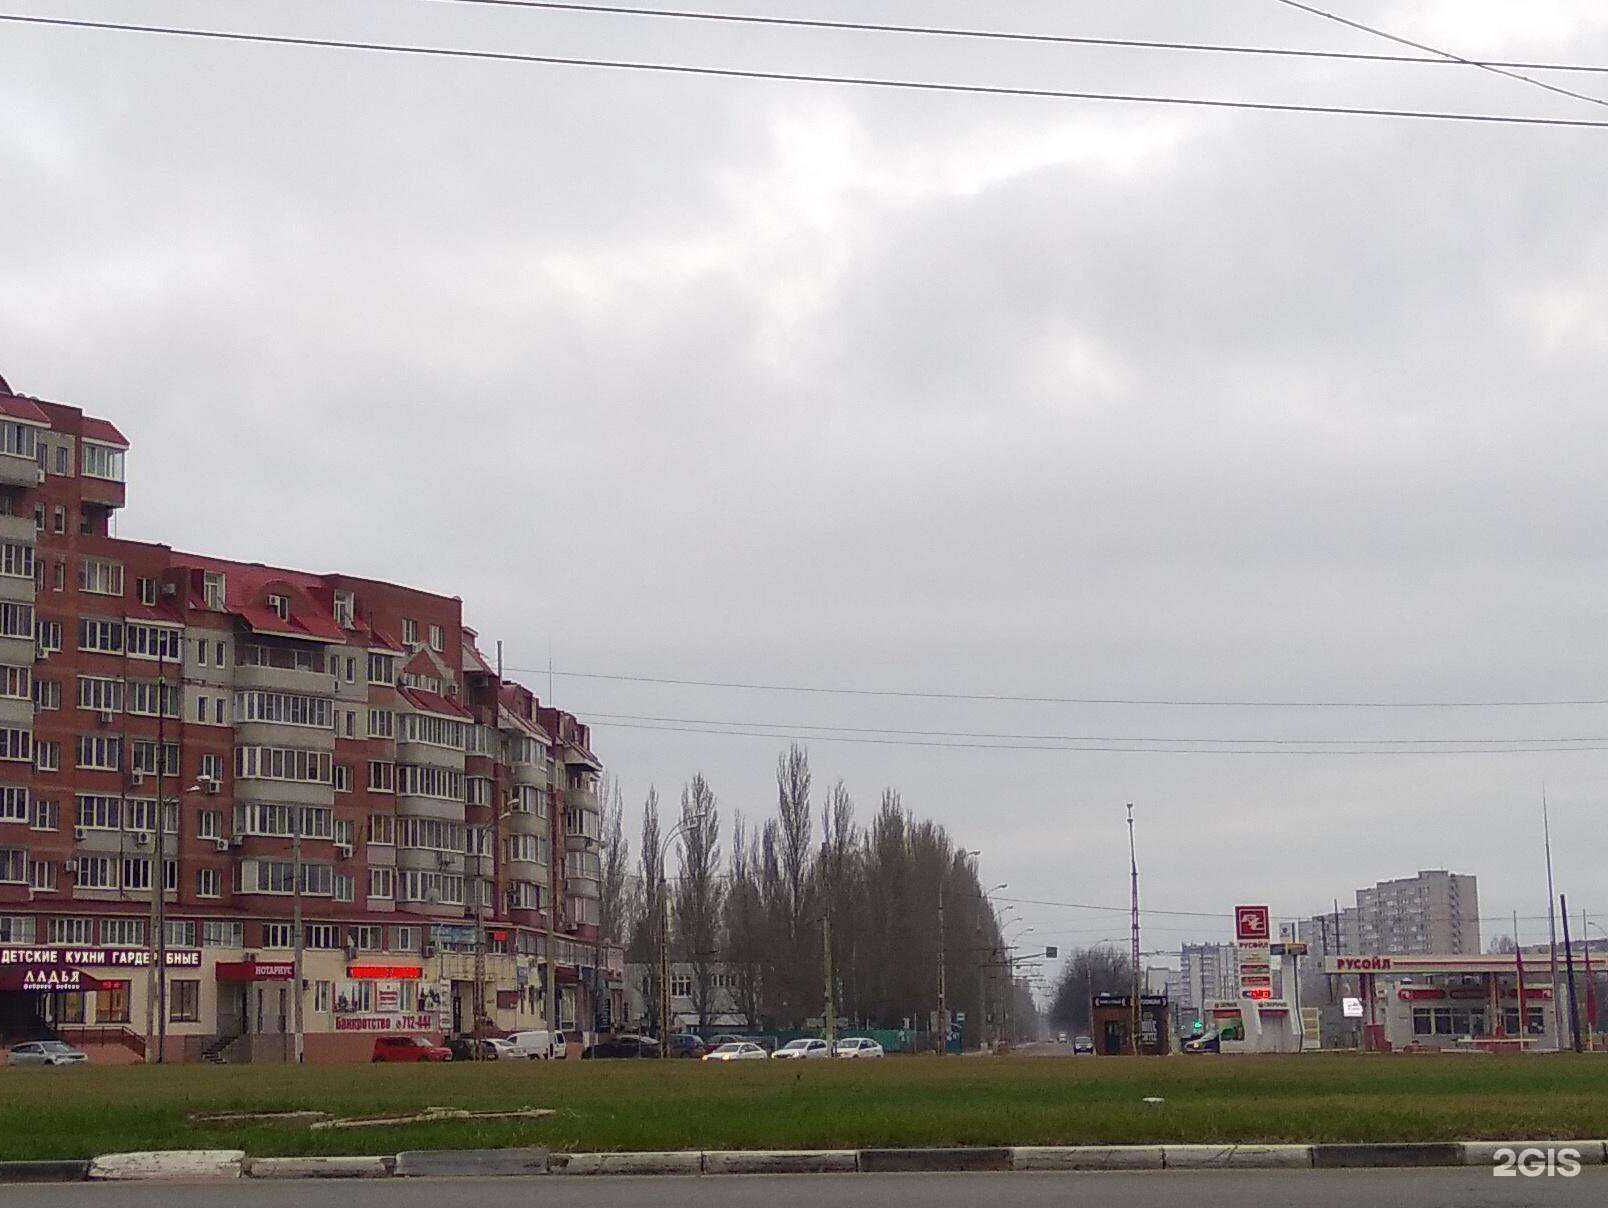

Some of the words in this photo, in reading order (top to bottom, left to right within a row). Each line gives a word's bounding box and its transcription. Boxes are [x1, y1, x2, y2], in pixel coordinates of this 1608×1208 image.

[1, 950, 58, 964] ДЕТСКИЕ
[65, 951, 105, 964] КУХНИ
[1337, 956, 1391, 969] РУСОЙЛ
[24, 970, 80, 984] ЛАДЬЯ
[255, 966, 292, 975] НОТАРИУС
[335, 1016, 391, 1030] Банкротство
